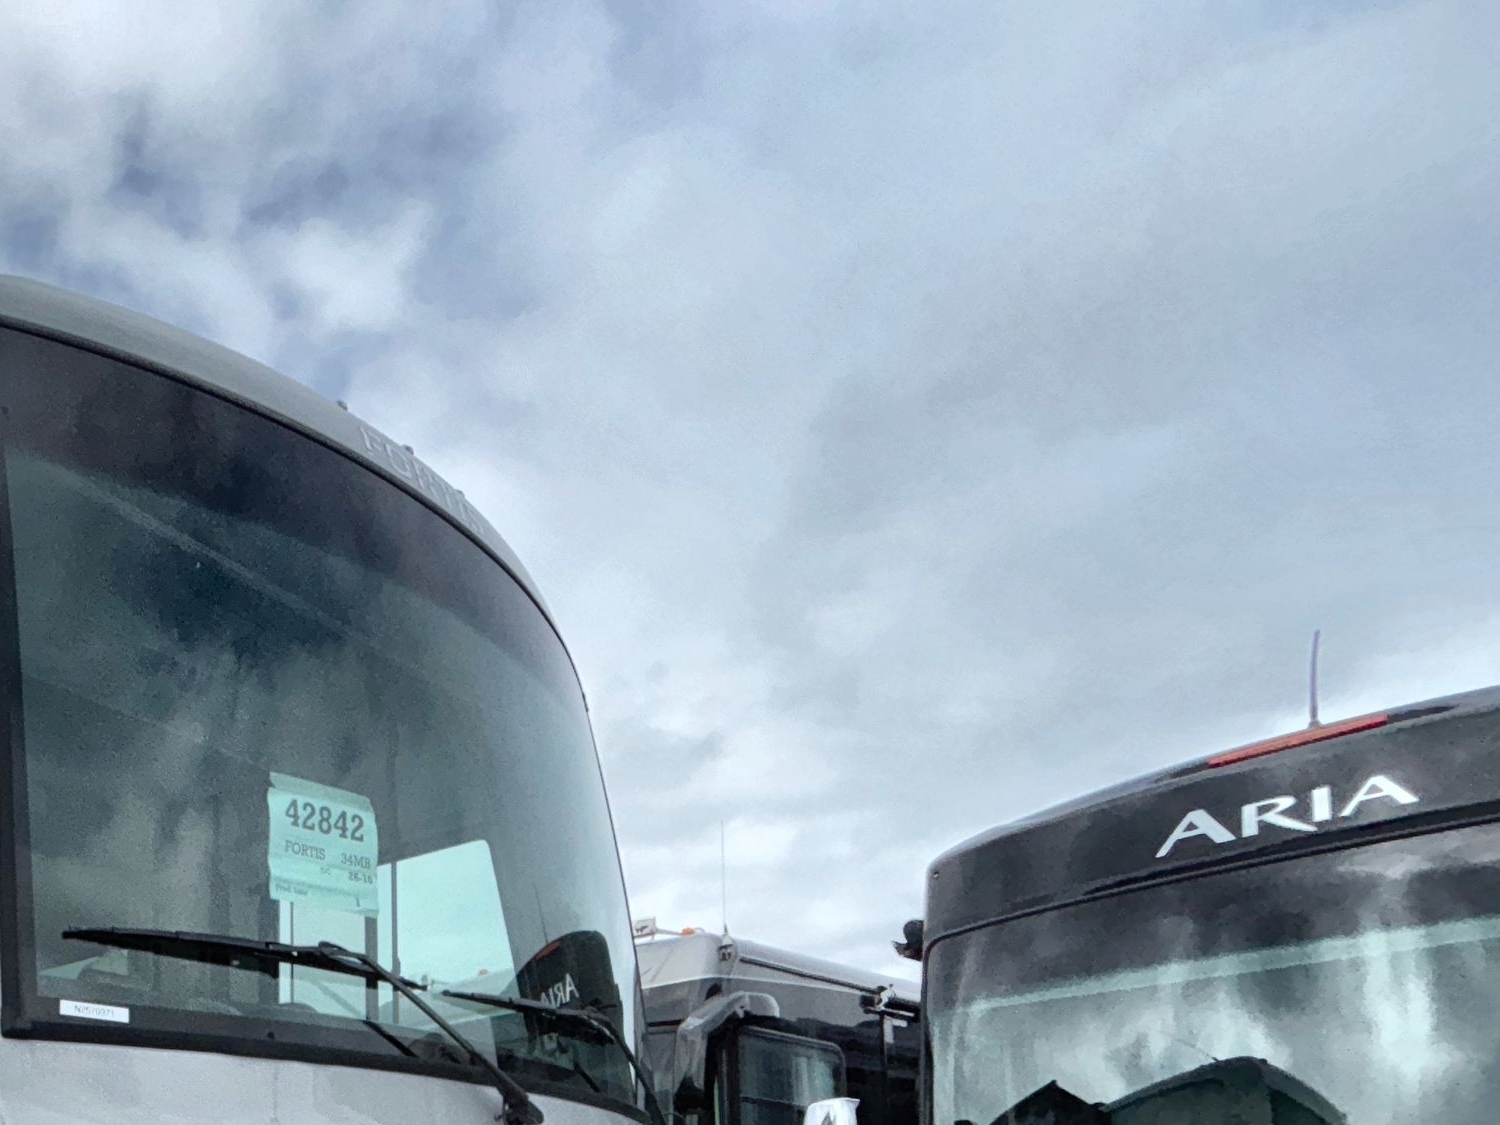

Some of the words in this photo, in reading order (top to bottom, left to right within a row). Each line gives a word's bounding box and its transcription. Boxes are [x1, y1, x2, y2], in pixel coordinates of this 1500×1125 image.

[285, 798, 365, 843] 42842
[1155, 774, 1420, 858] ARIA
[284, 839, 326, 861] FORTIS
